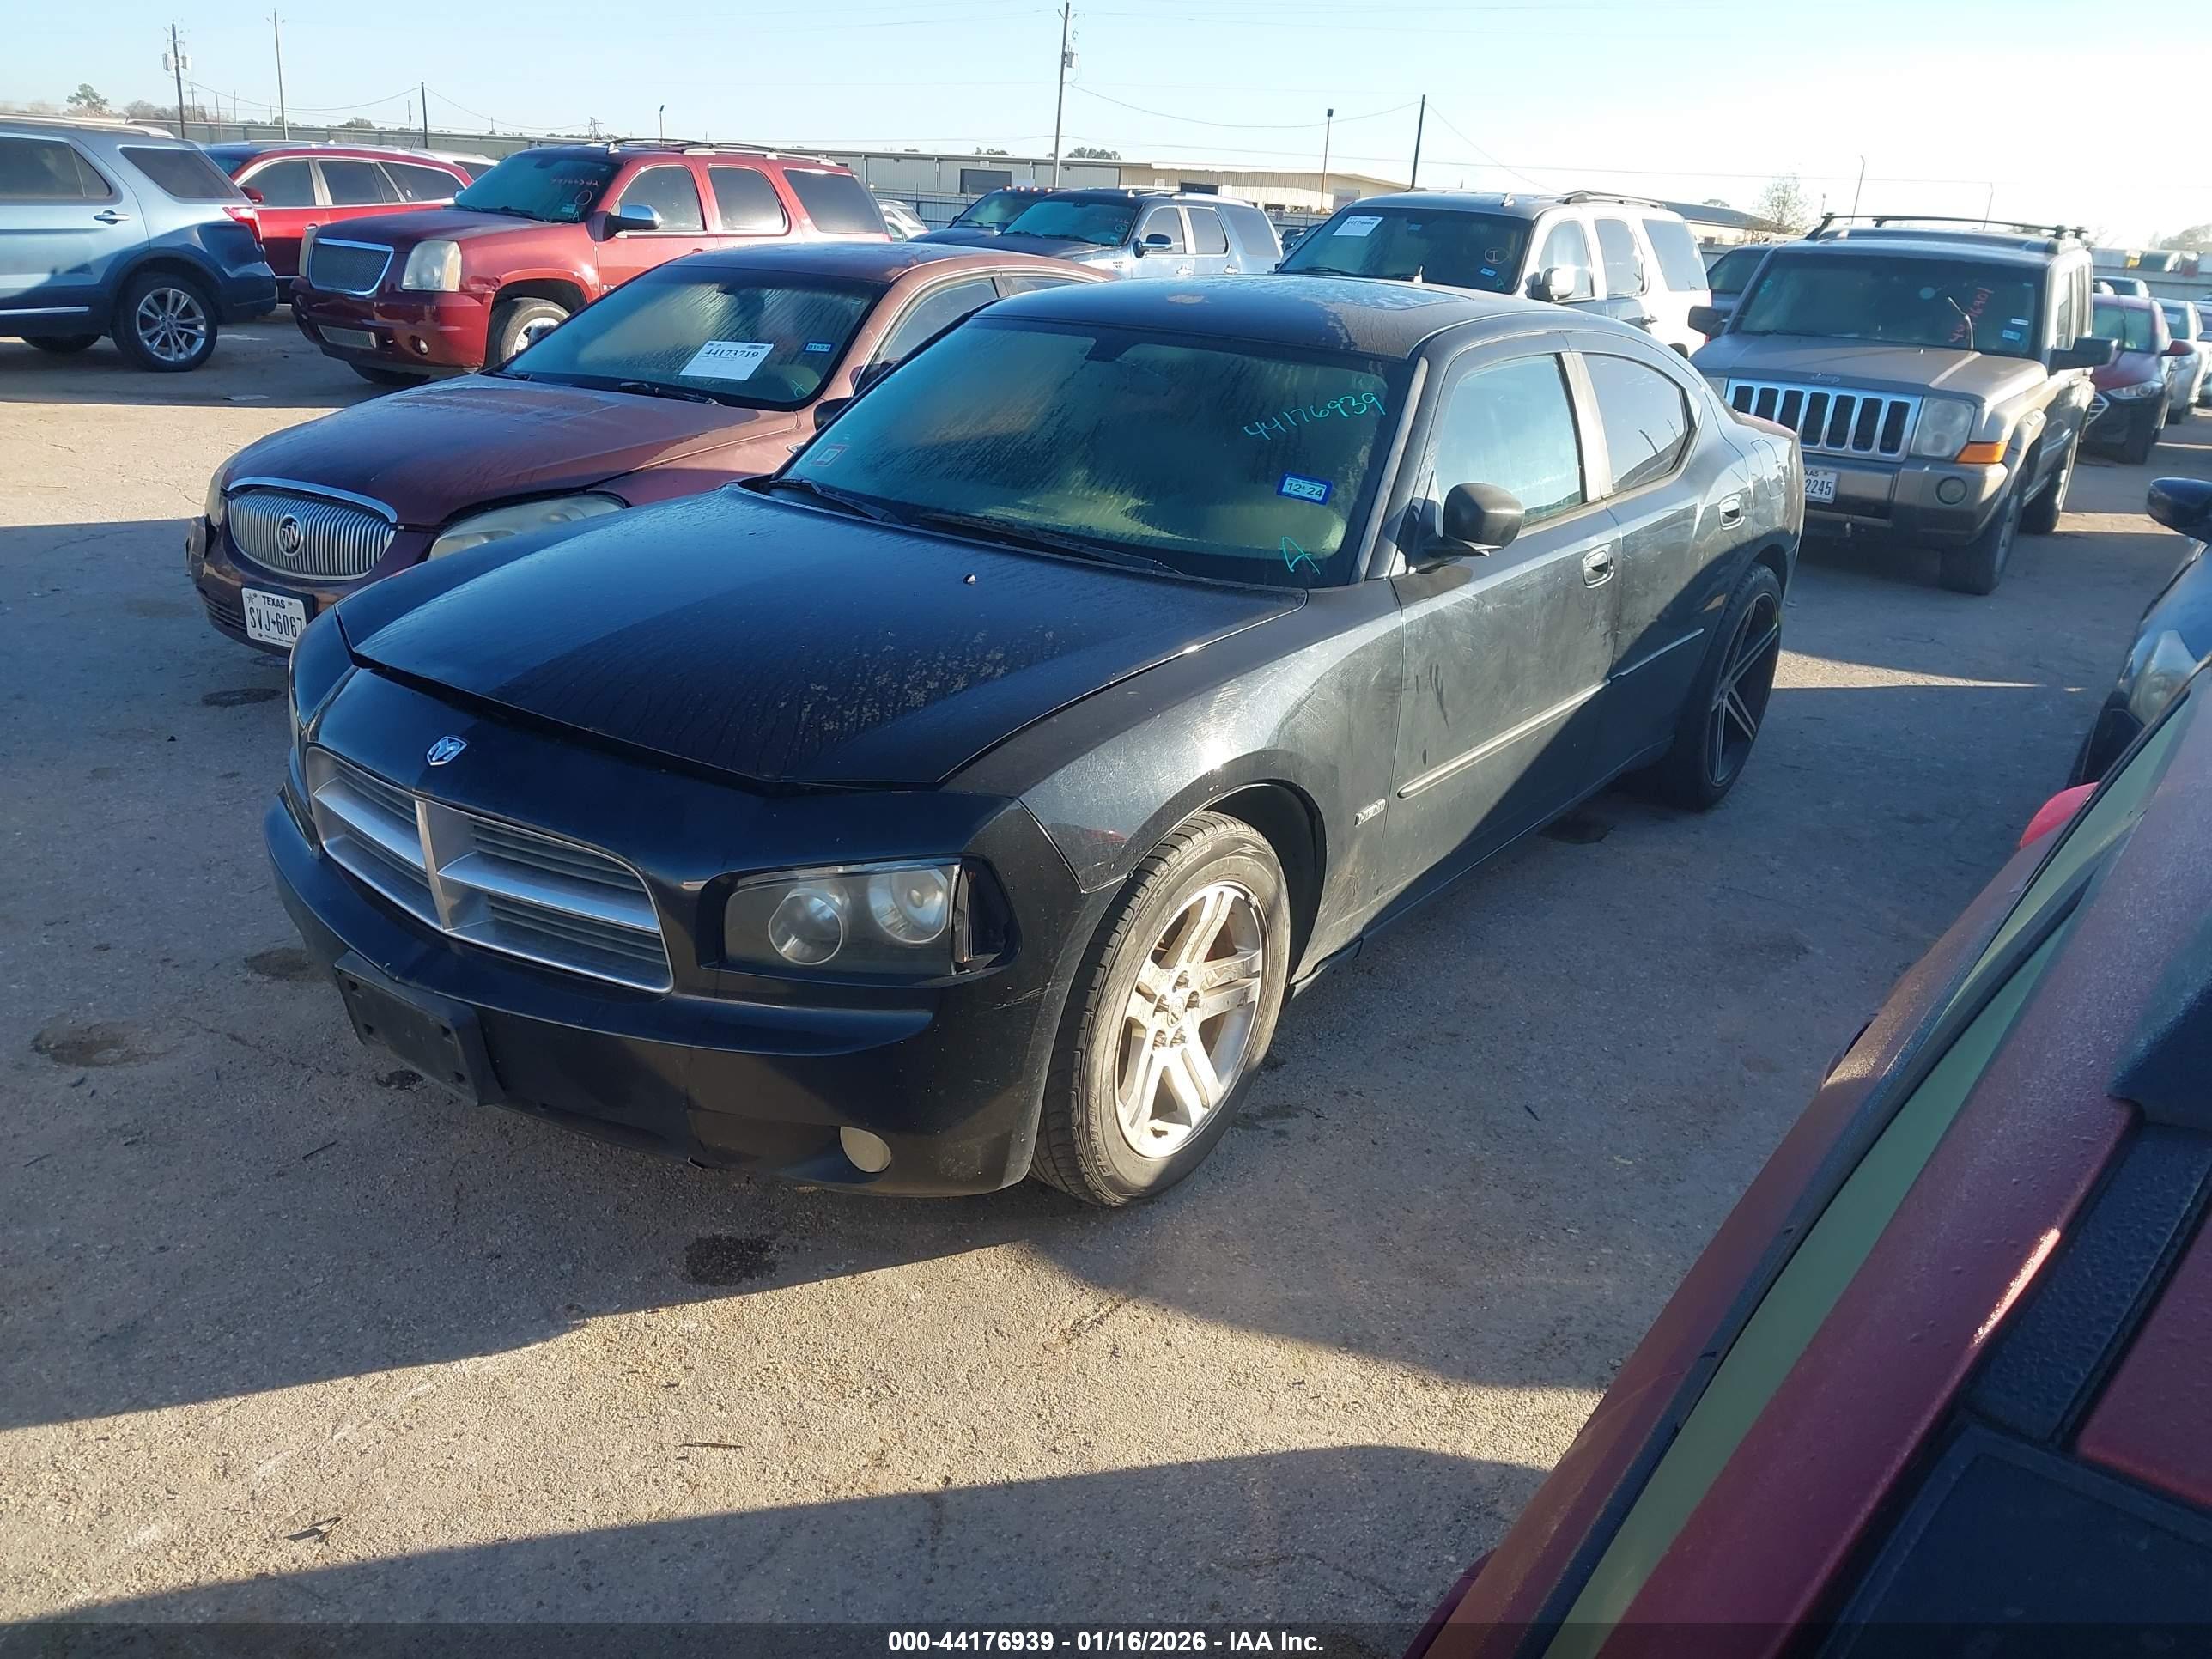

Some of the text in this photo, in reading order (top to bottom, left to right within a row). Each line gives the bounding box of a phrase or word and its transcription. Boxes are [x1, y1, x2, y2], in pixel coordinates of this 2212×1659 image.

[704, 349, 760, 359] 44173719
[1243, 392, 1386, 441] 44176939
[1281, 536, 1321, 575] A
[261, 595, 286, 610] TEXAS
